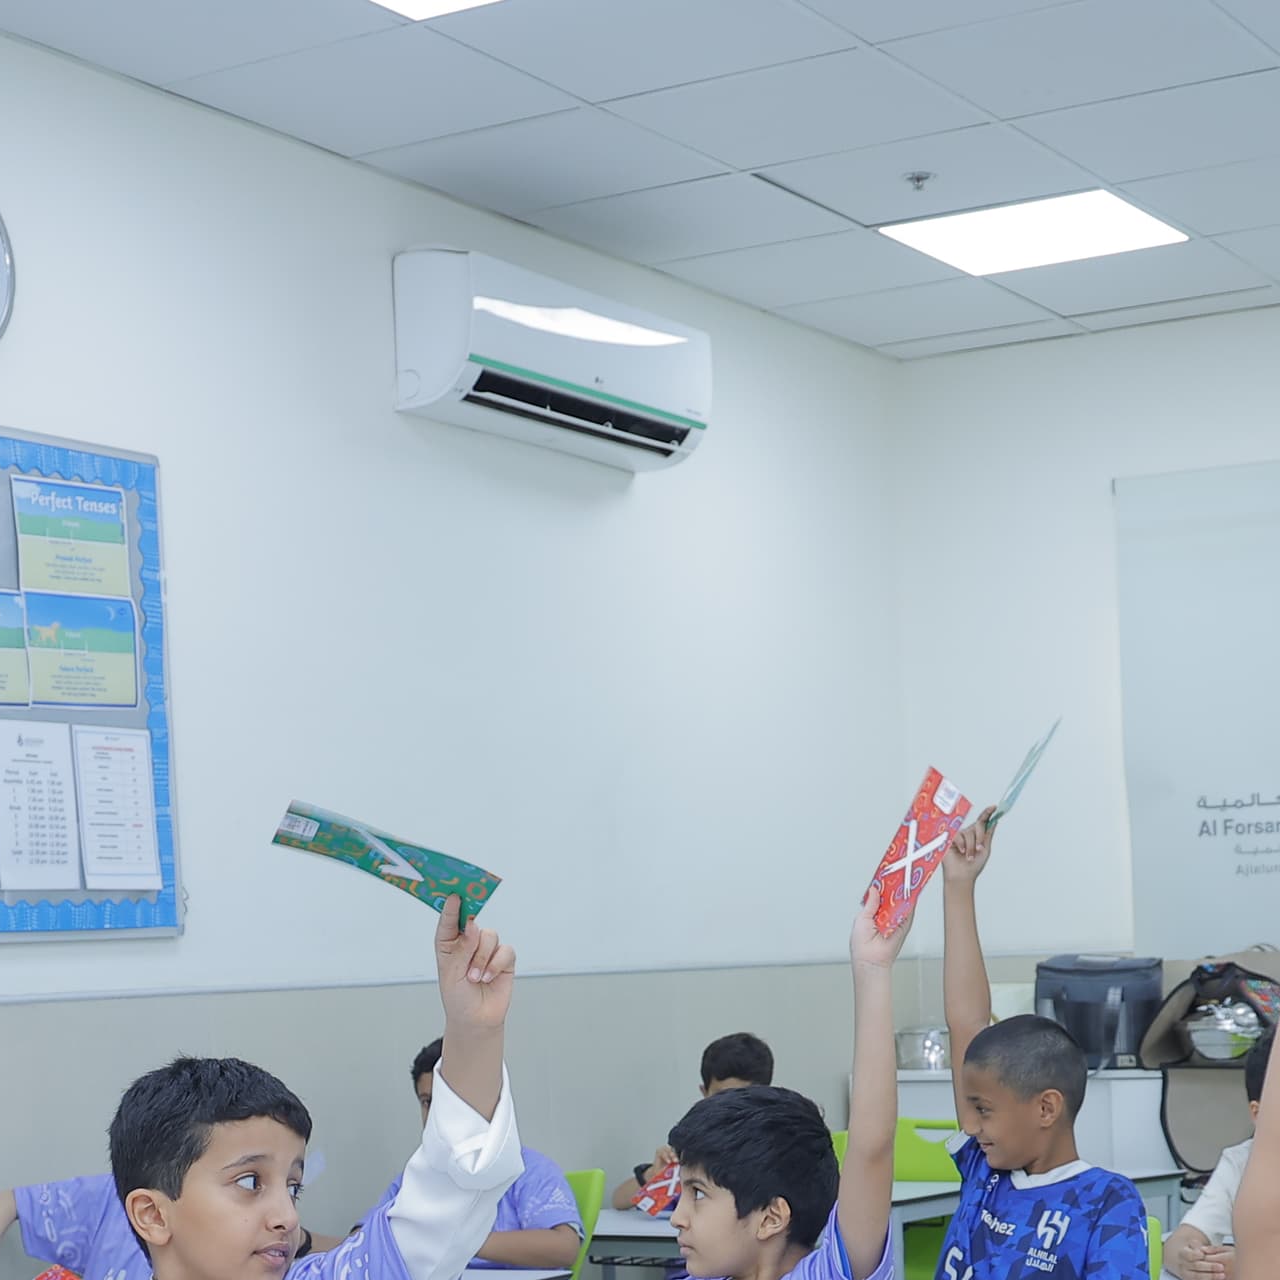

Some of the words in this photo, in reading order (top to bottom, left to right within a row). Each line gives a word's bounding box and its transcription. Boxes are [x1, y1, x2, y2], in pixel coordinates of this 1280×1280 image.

[31, 491, 73, 512] Perfect
[75, 496, 117, 514] Tenses
[1198, 820, 1217, 837] Al
